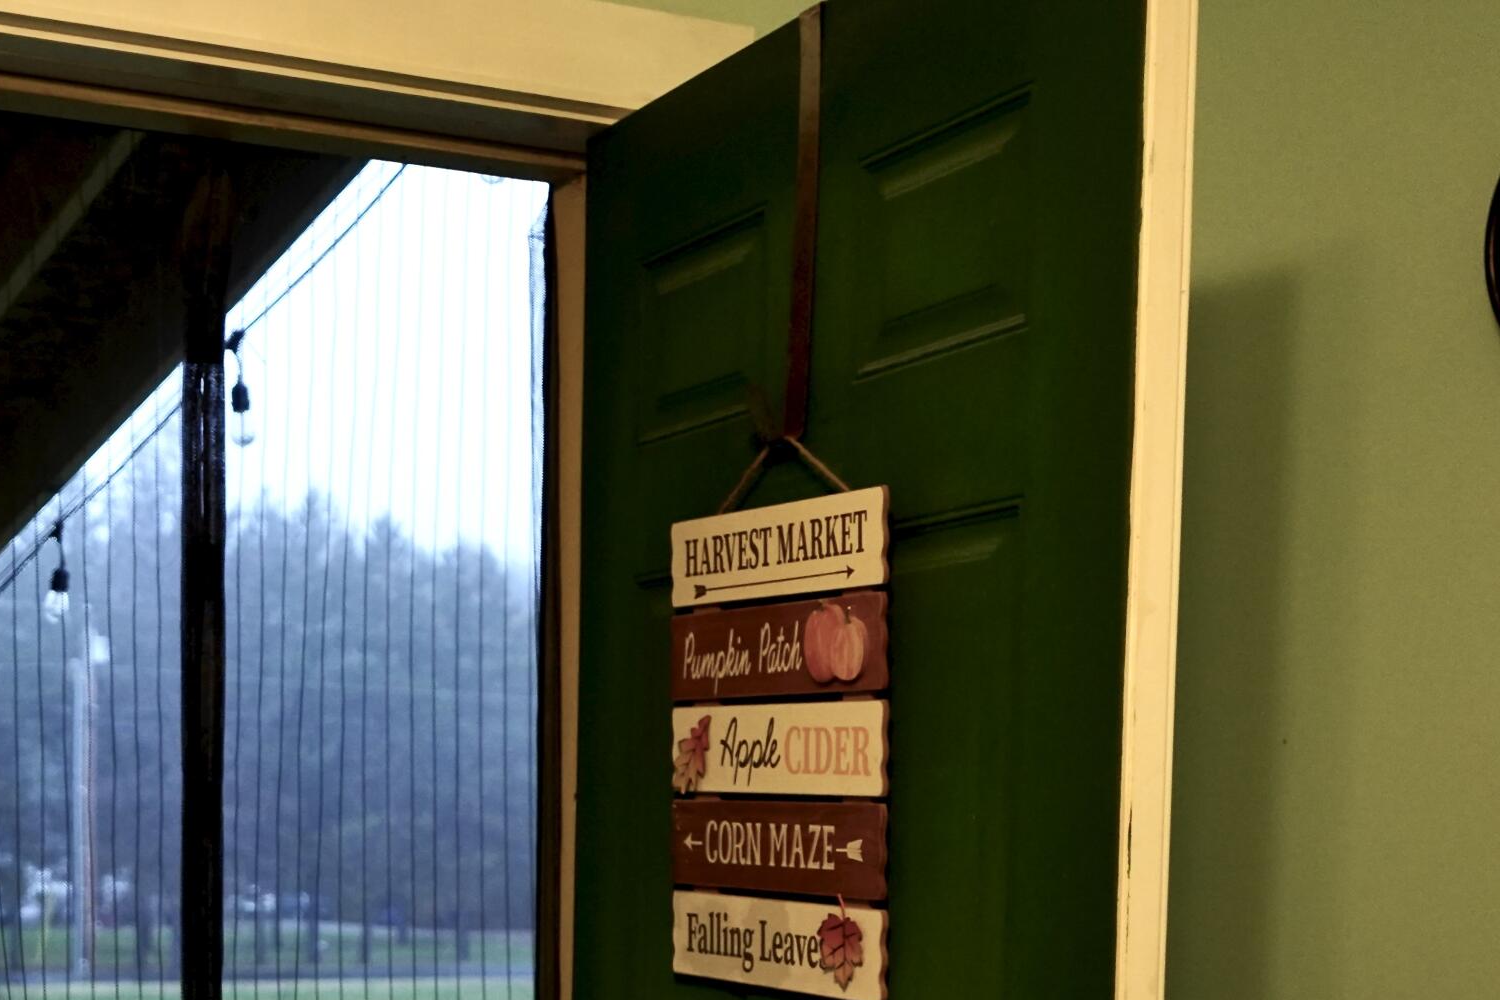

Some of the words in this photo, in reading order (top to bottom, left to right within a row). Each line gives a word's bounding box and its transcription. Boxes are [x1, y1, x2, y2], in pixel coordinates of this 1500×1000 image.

[685, 527, 772, 577] HARVEST
[776, 510, 868, 565] MARKET
[683, 628, 751, 696] Pumpkin
[758, 620, 803, 673] Patch
[720, 717, 781, 786] Apple
[784, 726, 871, 777] CIDER
[705, 820, 761, 866] CORN
[769, 824, 835, 870] MAZE
[686, 912, 755, 973] Falling
[758, 920, 825, 973] Leave
